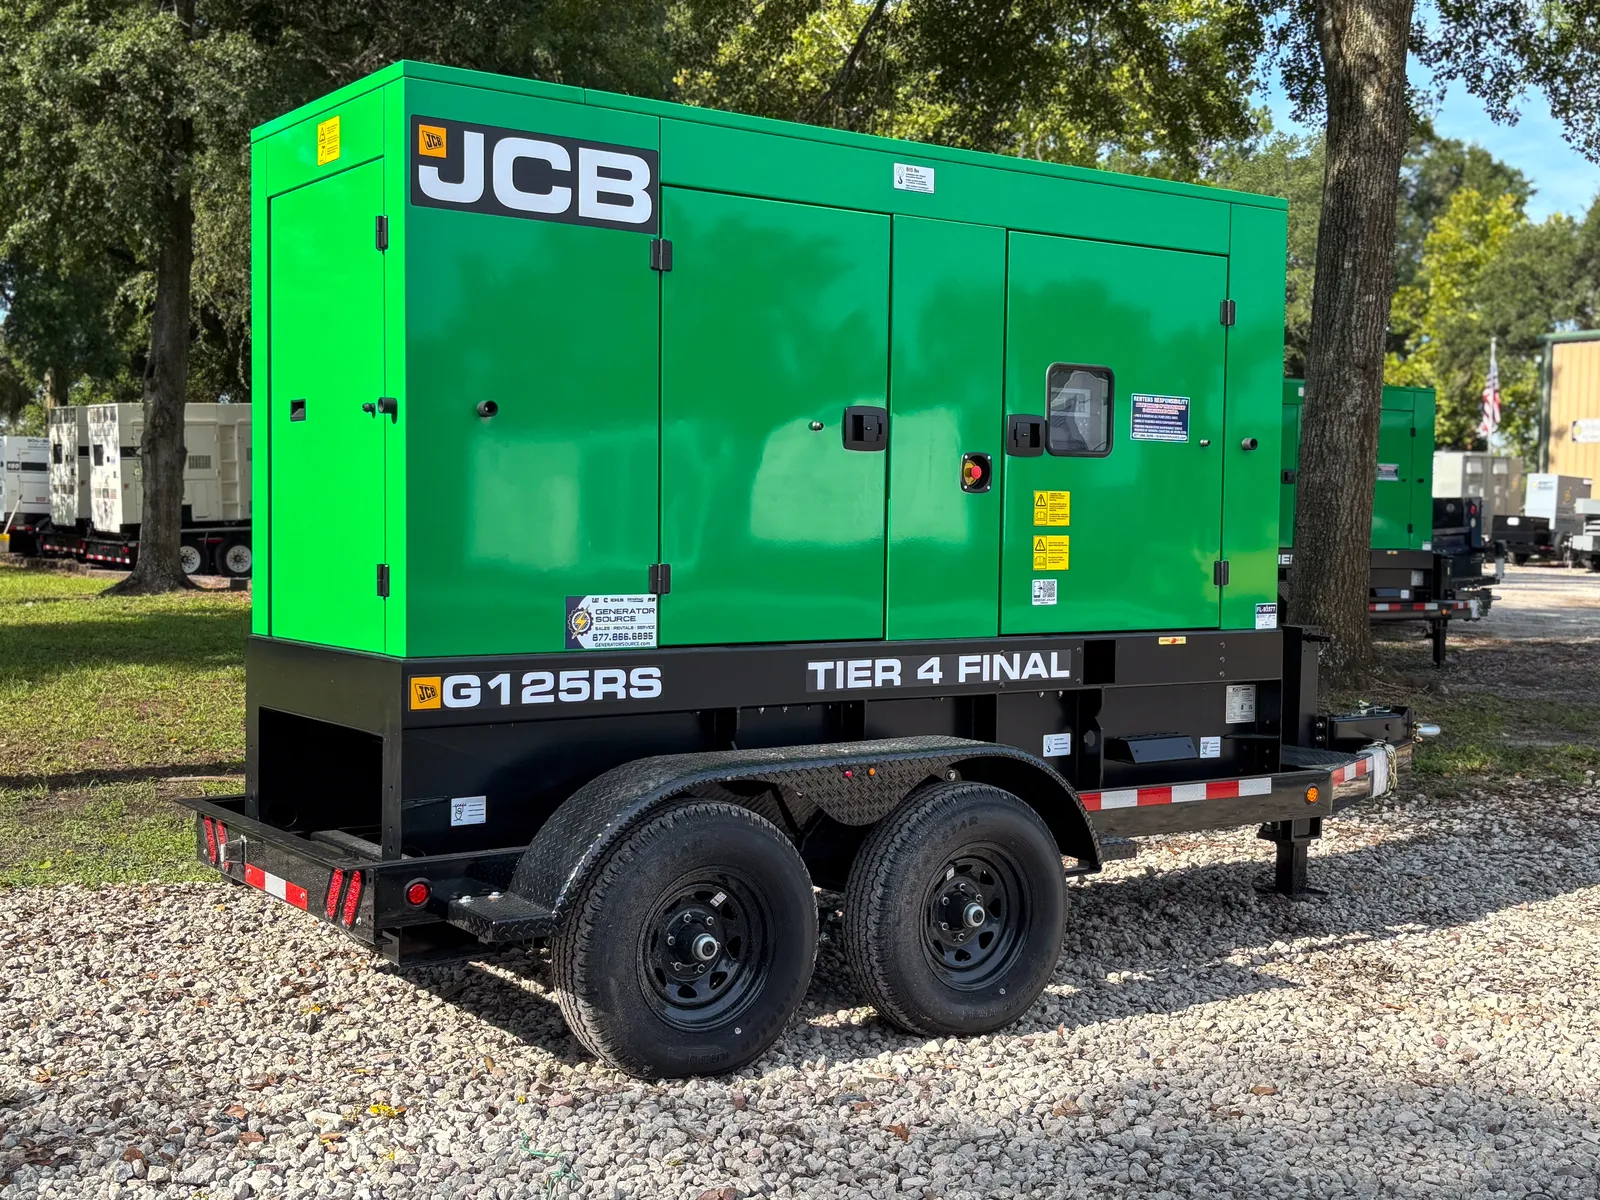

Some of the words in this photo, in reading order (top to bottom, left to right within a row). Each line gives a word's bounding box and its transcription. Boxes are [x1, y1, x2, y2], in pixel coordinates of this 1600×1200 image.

[424, 132, 443, 149] JCB
[418, 130, 652, 225] JCB
[592, 632, 654, 641] 877.866.6895
[808, 658, 902, 691] TIER
[917, 656, 943, 684] 4
[958, 652, 1070, 682] FINAL
[417, 684, 437, 702] JCB
[443, 667, 662, 709] G125RS
